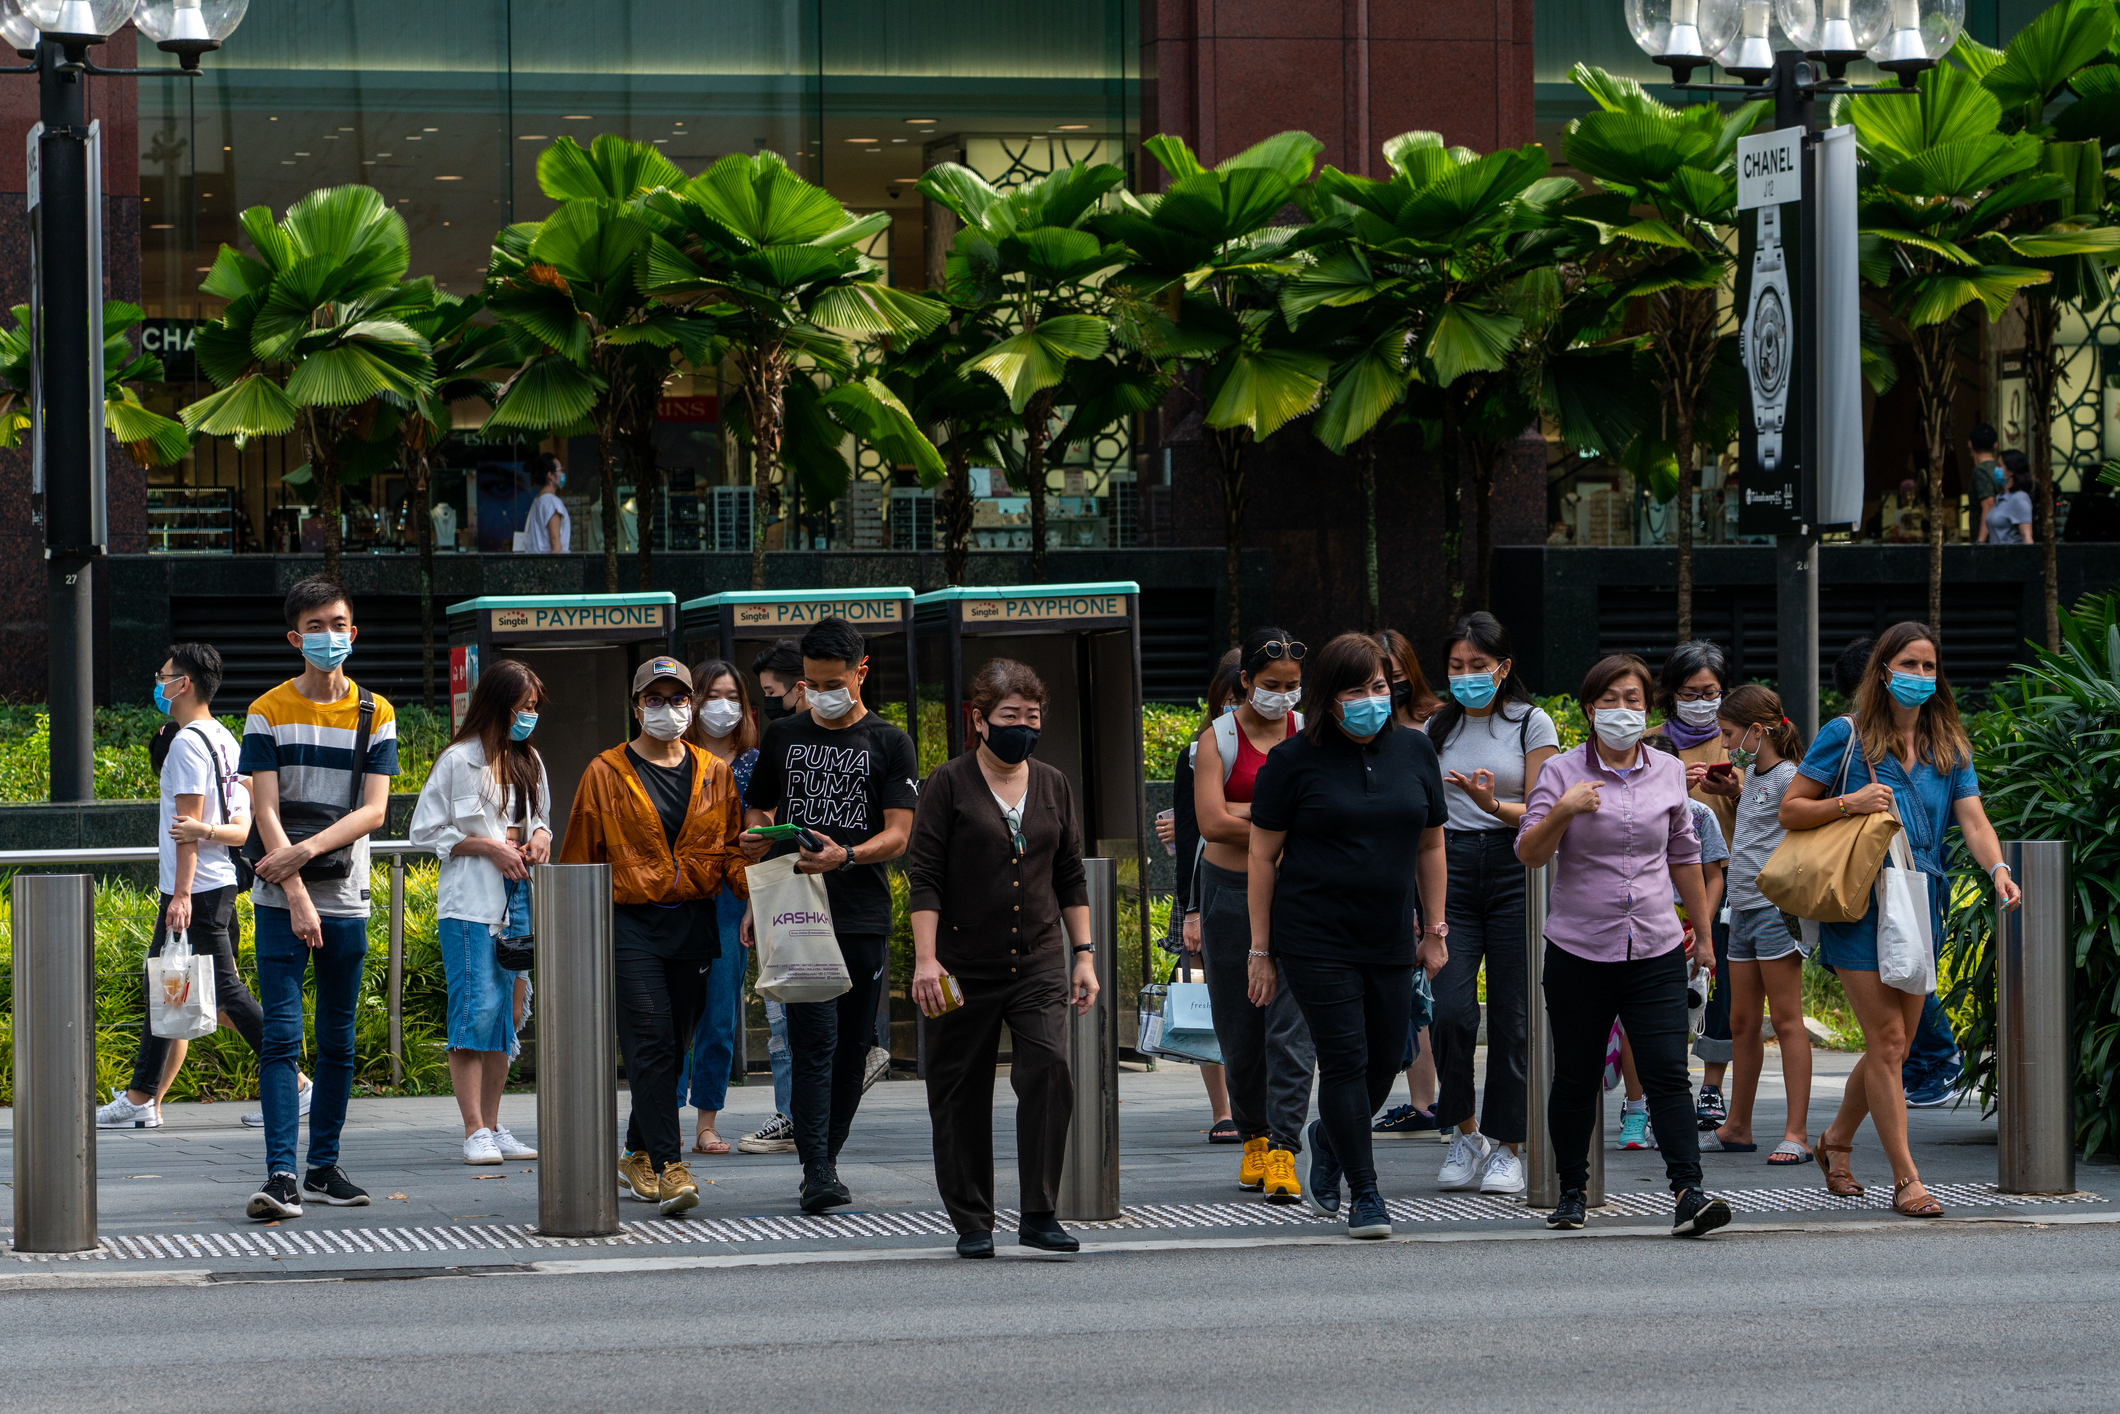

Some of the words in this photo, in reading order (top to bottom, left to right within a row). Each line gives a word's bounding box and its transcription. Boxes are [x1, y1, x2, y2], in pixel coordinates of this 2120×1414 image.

[1744, 146, 1793, 179] CHANEL
[1764, 180, 1774, 198] J12
[1796, 560, 1809, 571] 28
[65, 574, 78, 585] 27
[499, 616, 528, 628] Singtel
[536, 607, 656, 627] PAYPHONE
[740, 610, 770, 623] Singtel
[777, 602, 895, 622] PAYPHONE
[971, 606, 999, 618] Singtel
[1006, 598, 1118, 618] PAYPHONE
[785, 744, 870, 776] PUMA
[786, 770, 868, 803] PUMA
[786, 798, 868, 830] PUMA
[1190, 1001, 1211, 1010] fresh
